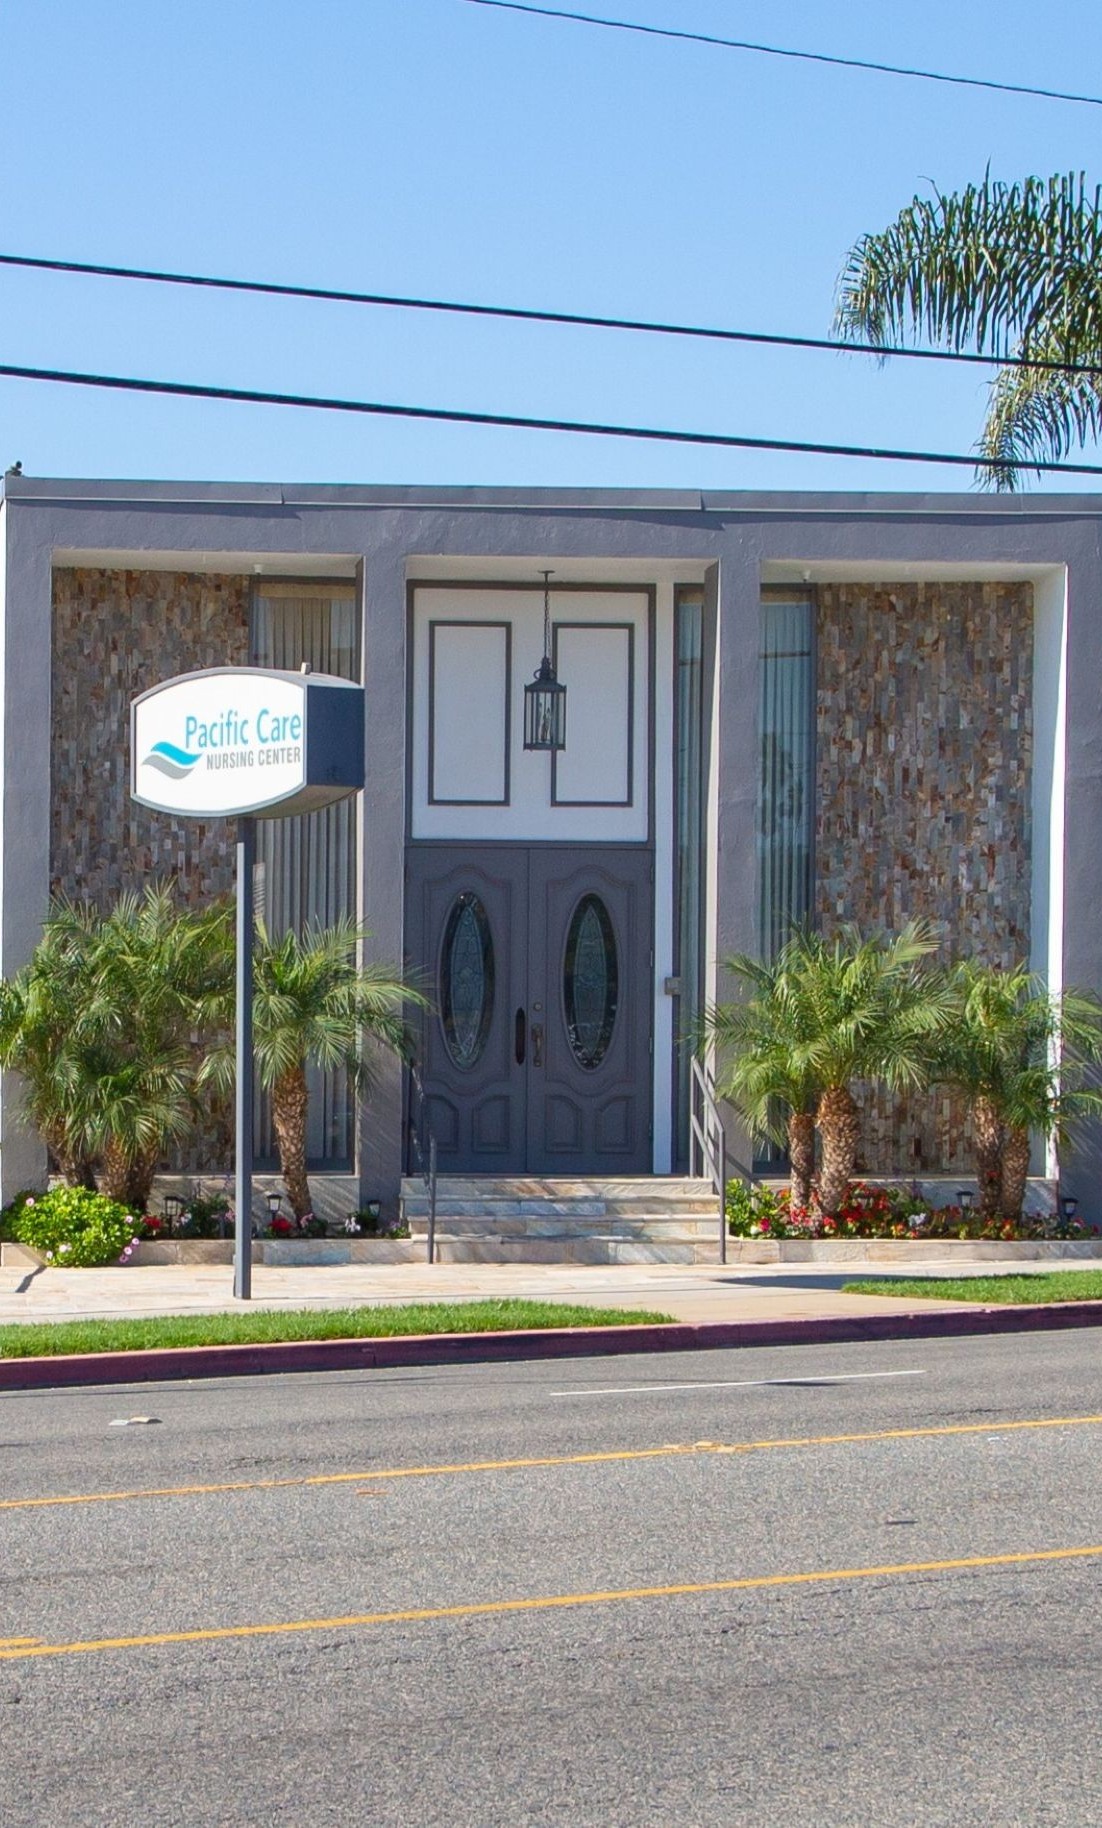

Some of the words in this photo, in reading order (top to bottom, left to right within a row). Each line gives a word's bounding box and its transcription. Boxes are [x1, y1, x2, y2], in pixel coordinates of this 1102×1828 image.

[186, 709, 249, 749] Pacific
[256, 708, 301, 743] Care
[206, 750, 254, 770] NURSING
[258, 746, 301, 765] CENTER
